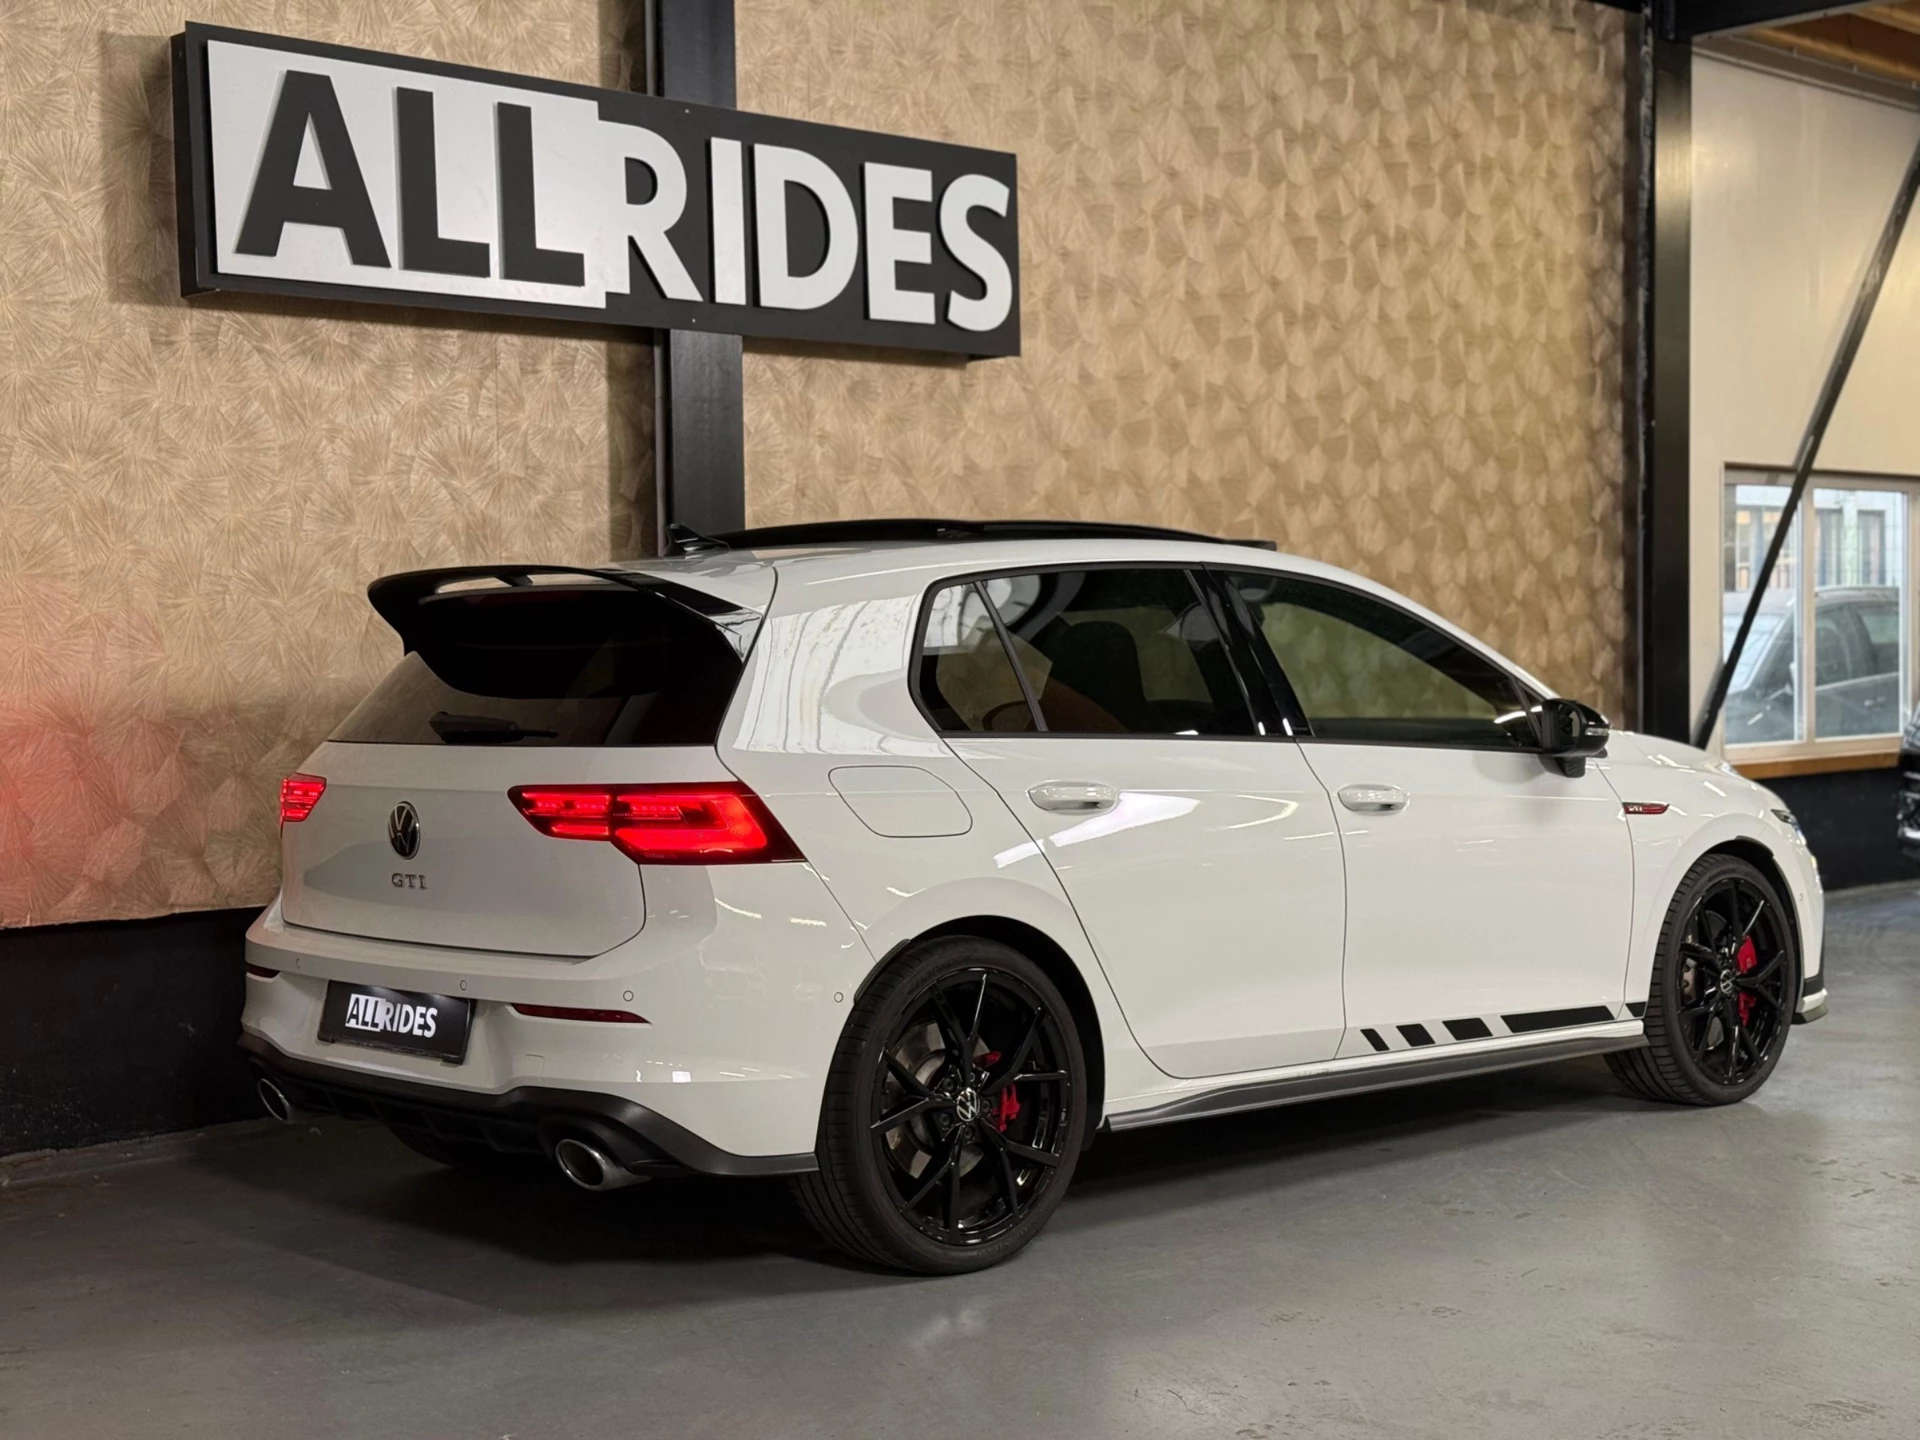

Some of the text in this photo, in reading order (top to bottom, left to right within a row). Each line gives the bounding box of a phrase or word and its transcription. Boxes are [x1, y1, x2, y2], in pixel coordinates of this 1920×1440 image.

[234, 69, 1014, 331] ALLRIDES
[391, 872, 427, 890] GTI
[346, 996, 438, 1038] ALLRIDES
